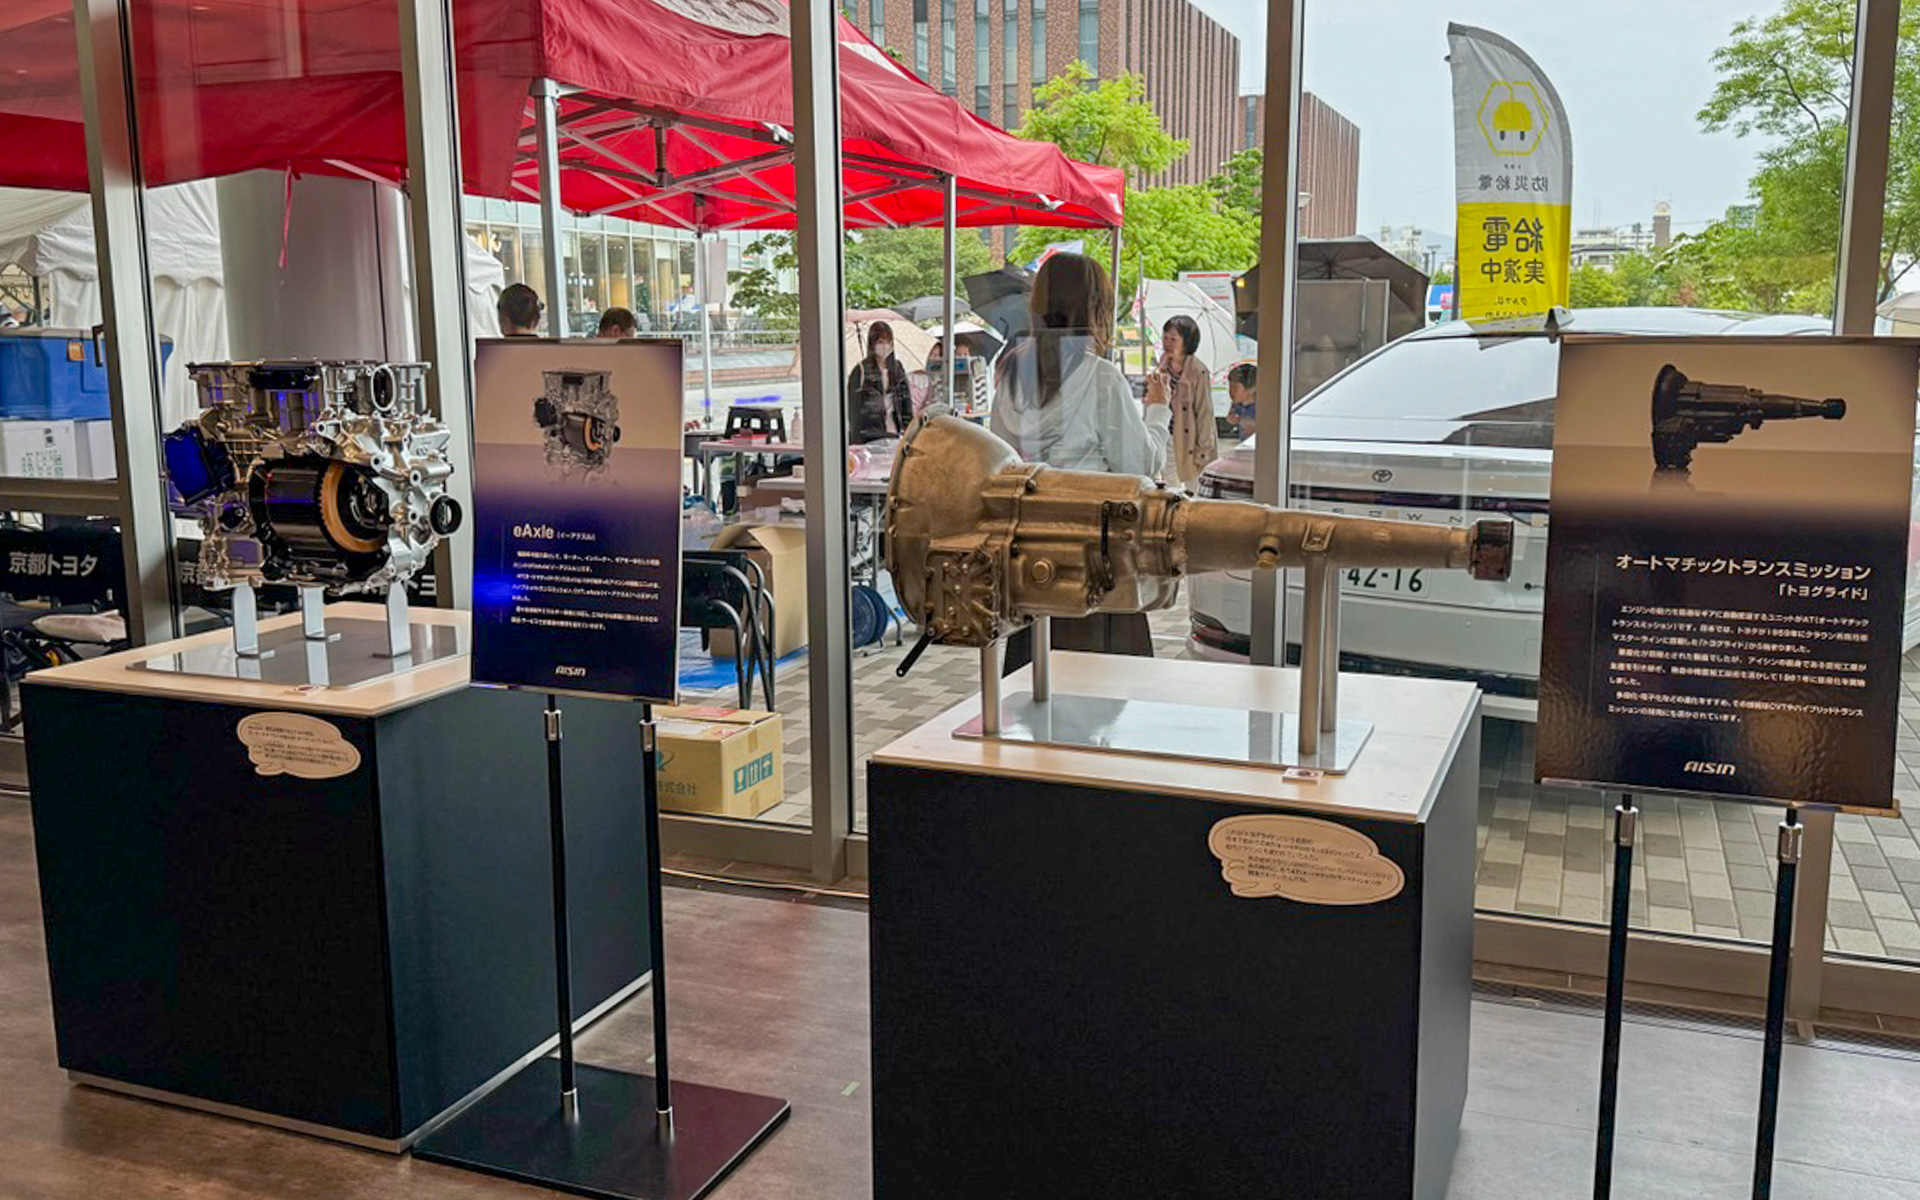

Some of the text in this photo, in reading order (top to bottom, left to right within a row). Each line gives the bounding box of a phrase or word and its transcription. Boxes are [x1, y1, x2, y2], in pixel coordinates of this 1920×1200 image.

[513, 523, 555, 539] eAxle
[8, 551, 99, 578] 京都トヨタ
[1616, 554, 1872, 581] オートマチックトランスミッション
[1779, 581, 1868, 600] 「トヨグライド」
[555, 665, 587, 678] AISIN
[1683, 760, 1736, 776] AISIN
